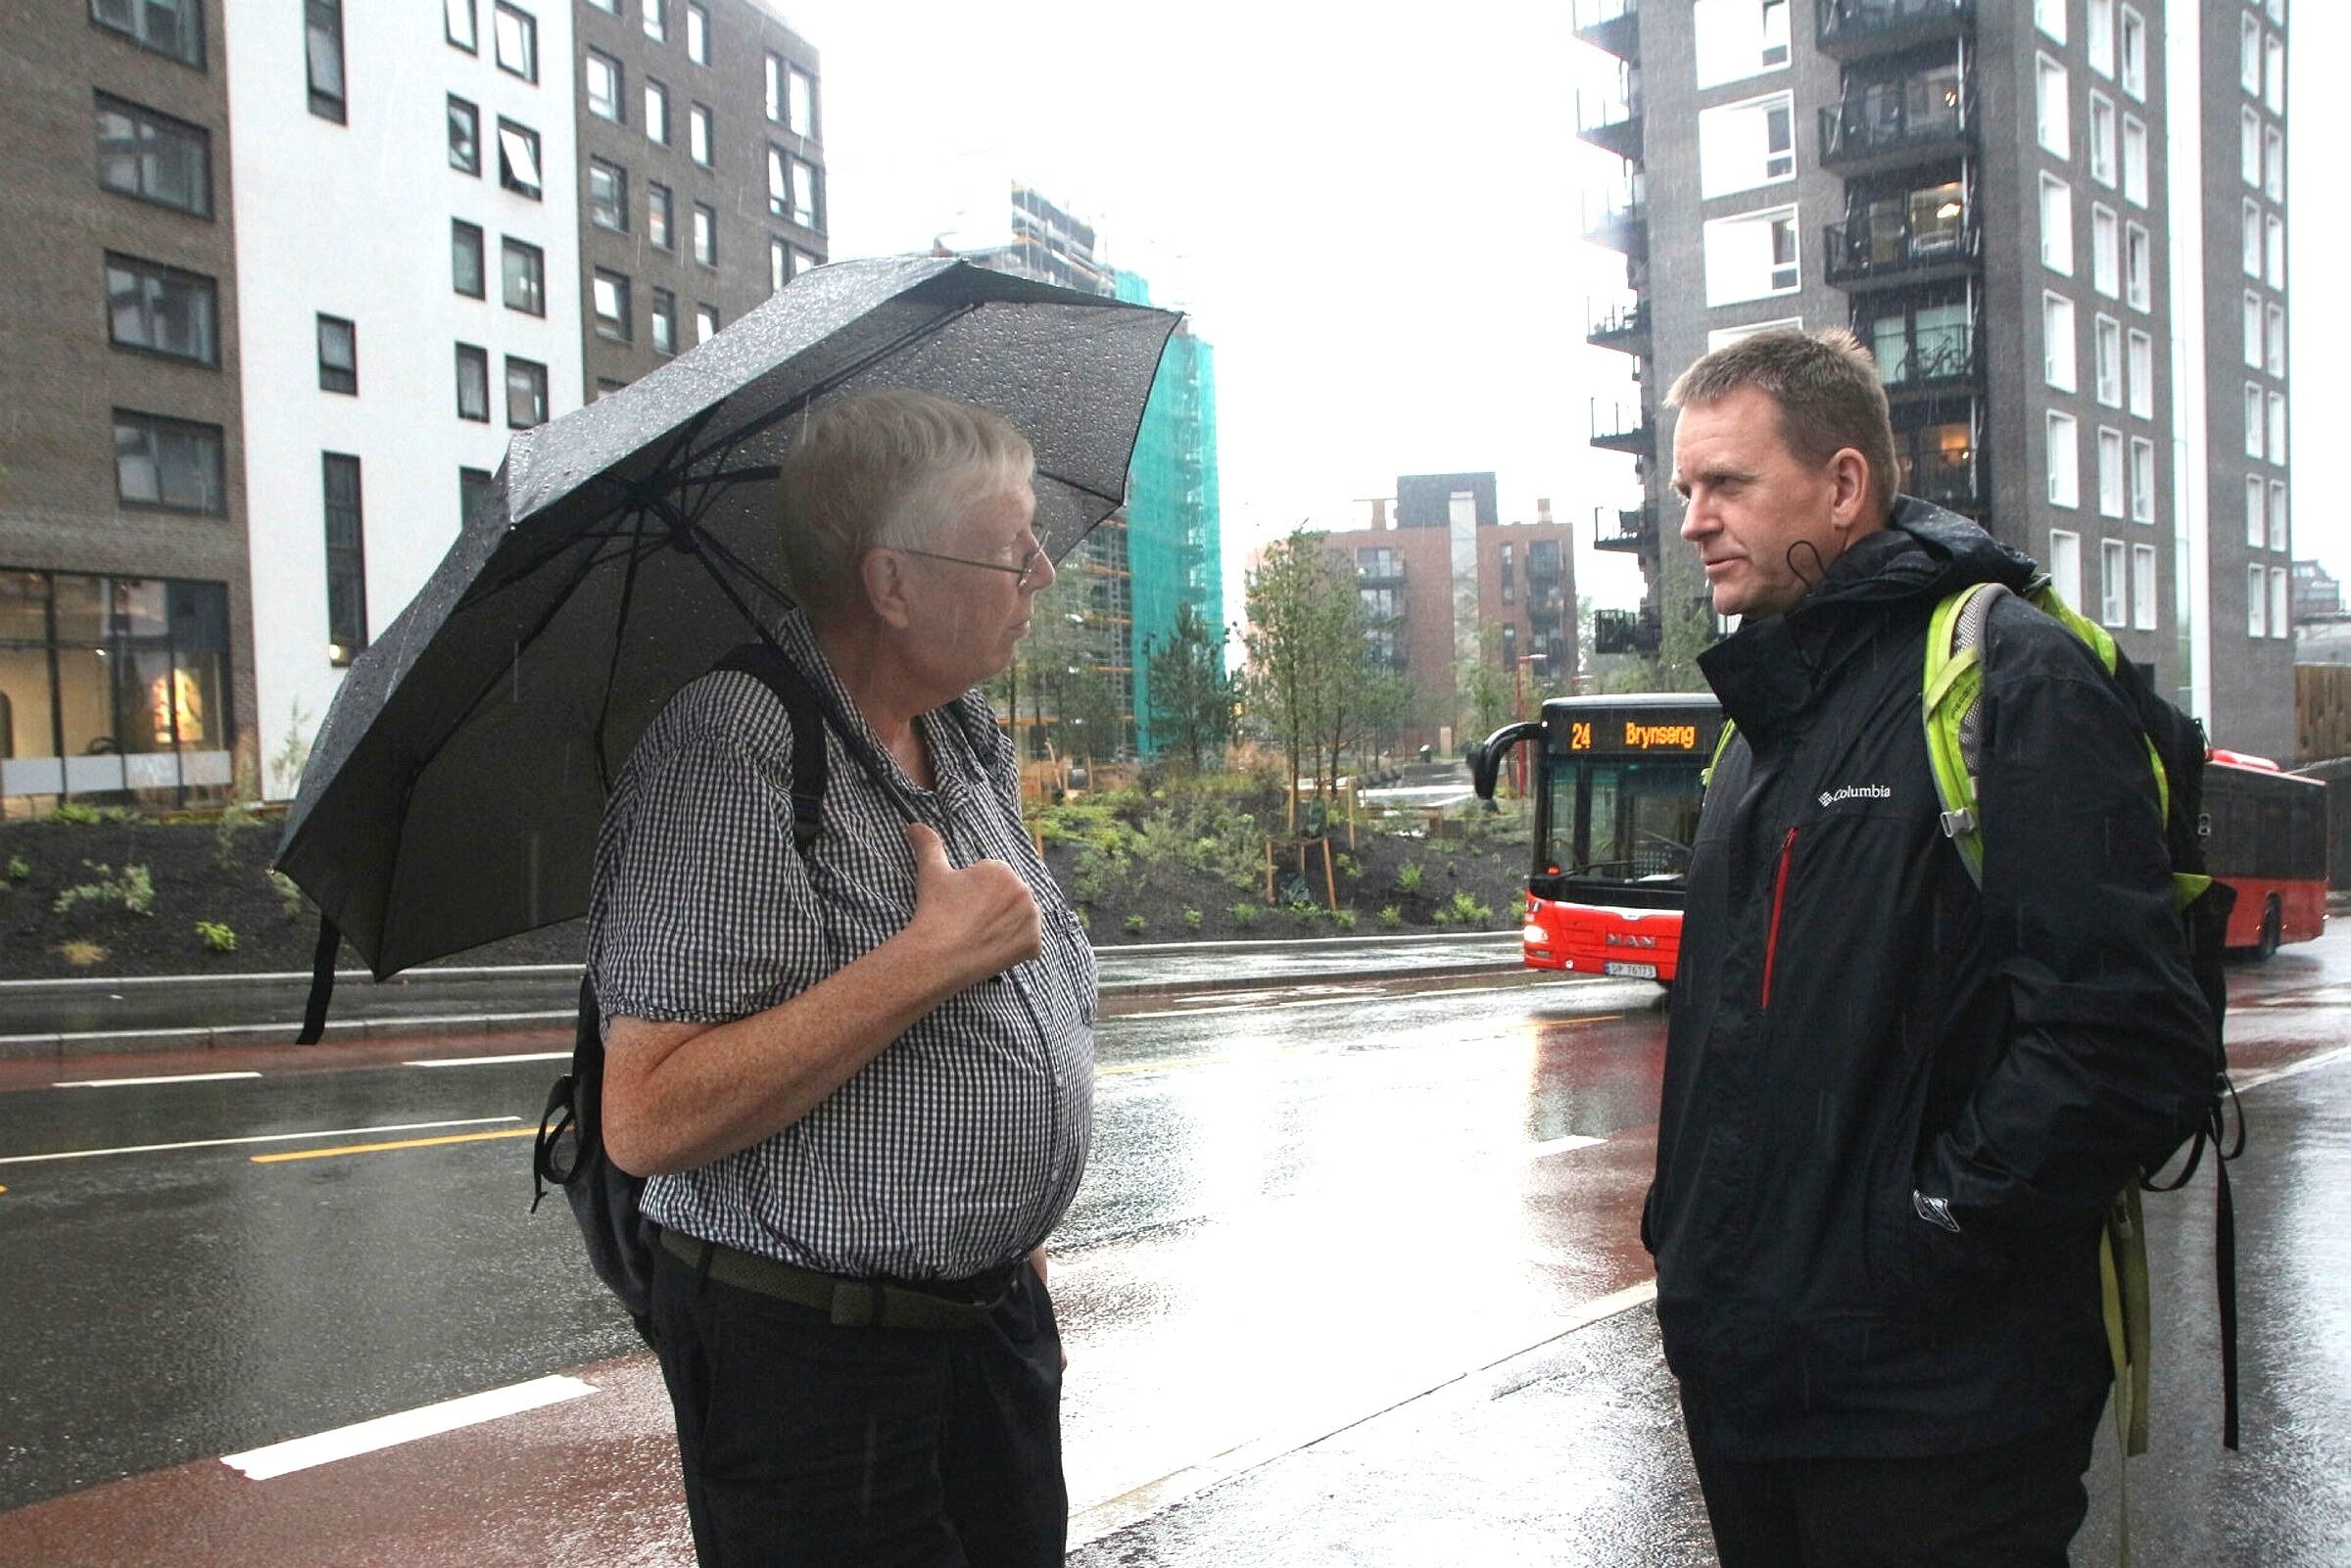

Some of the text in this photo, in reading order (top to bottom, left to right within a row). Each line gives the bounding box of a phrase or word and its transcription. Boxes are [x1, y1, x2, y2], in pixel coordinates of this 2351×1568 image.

[1571, 722, 1695, 749] 24 Brynseng
[1833, 784, 1891, 801] Columbia
[1607, 932, 1656, 948] MAN
